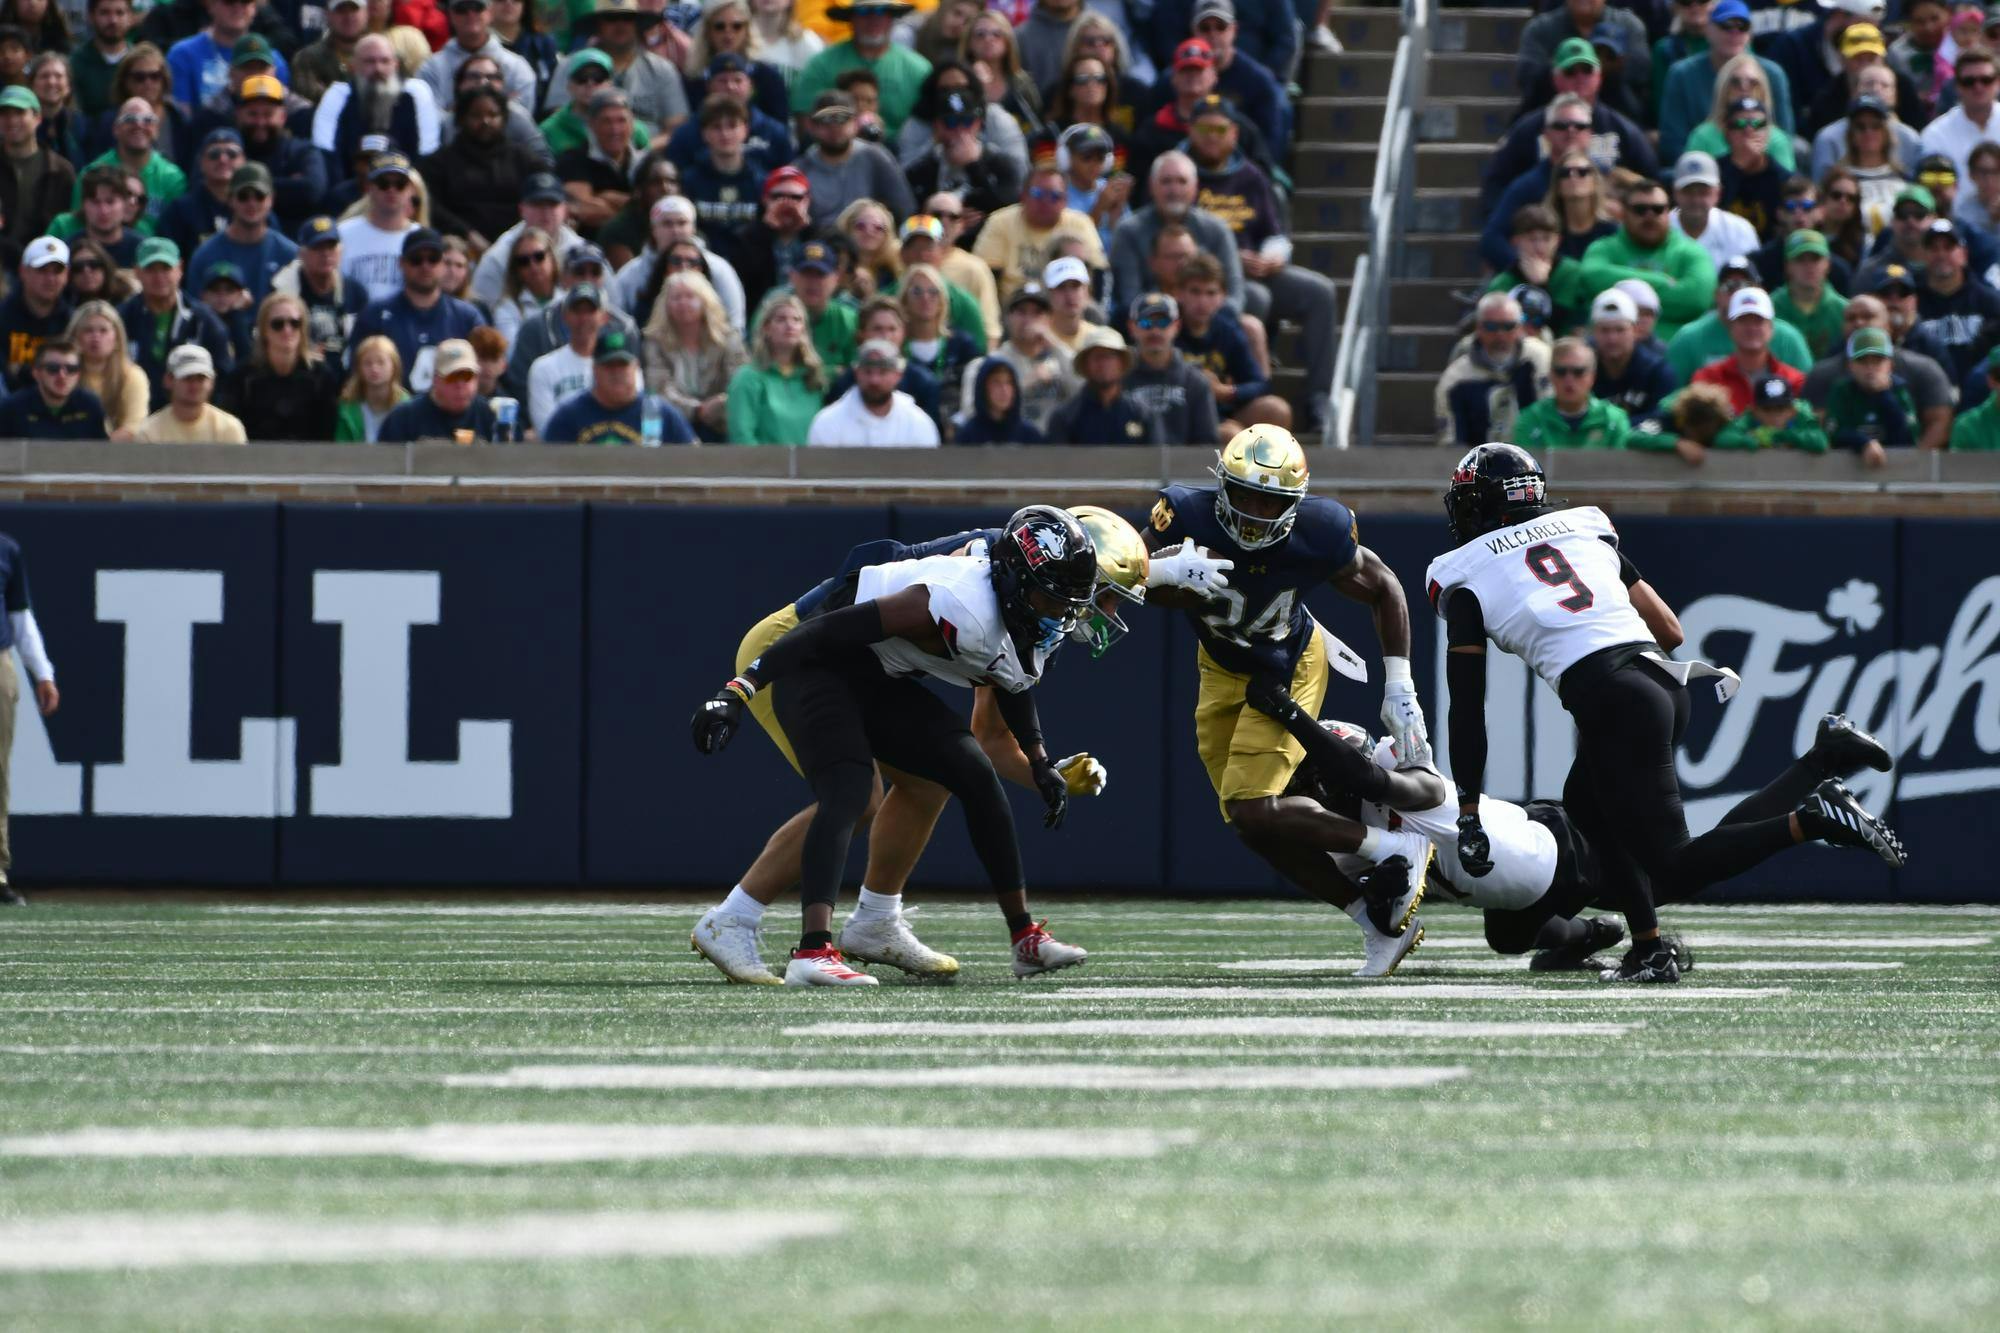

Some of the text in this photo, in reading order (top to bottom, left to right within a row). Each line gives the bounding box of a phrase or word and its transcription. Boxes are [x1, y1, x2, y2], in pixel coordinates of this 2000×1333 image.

[1485, 520, 1576, 555] VALCARCEL
[1524, 542, 1594, 615] 9
[1200, 587, 1297, 648] 24
